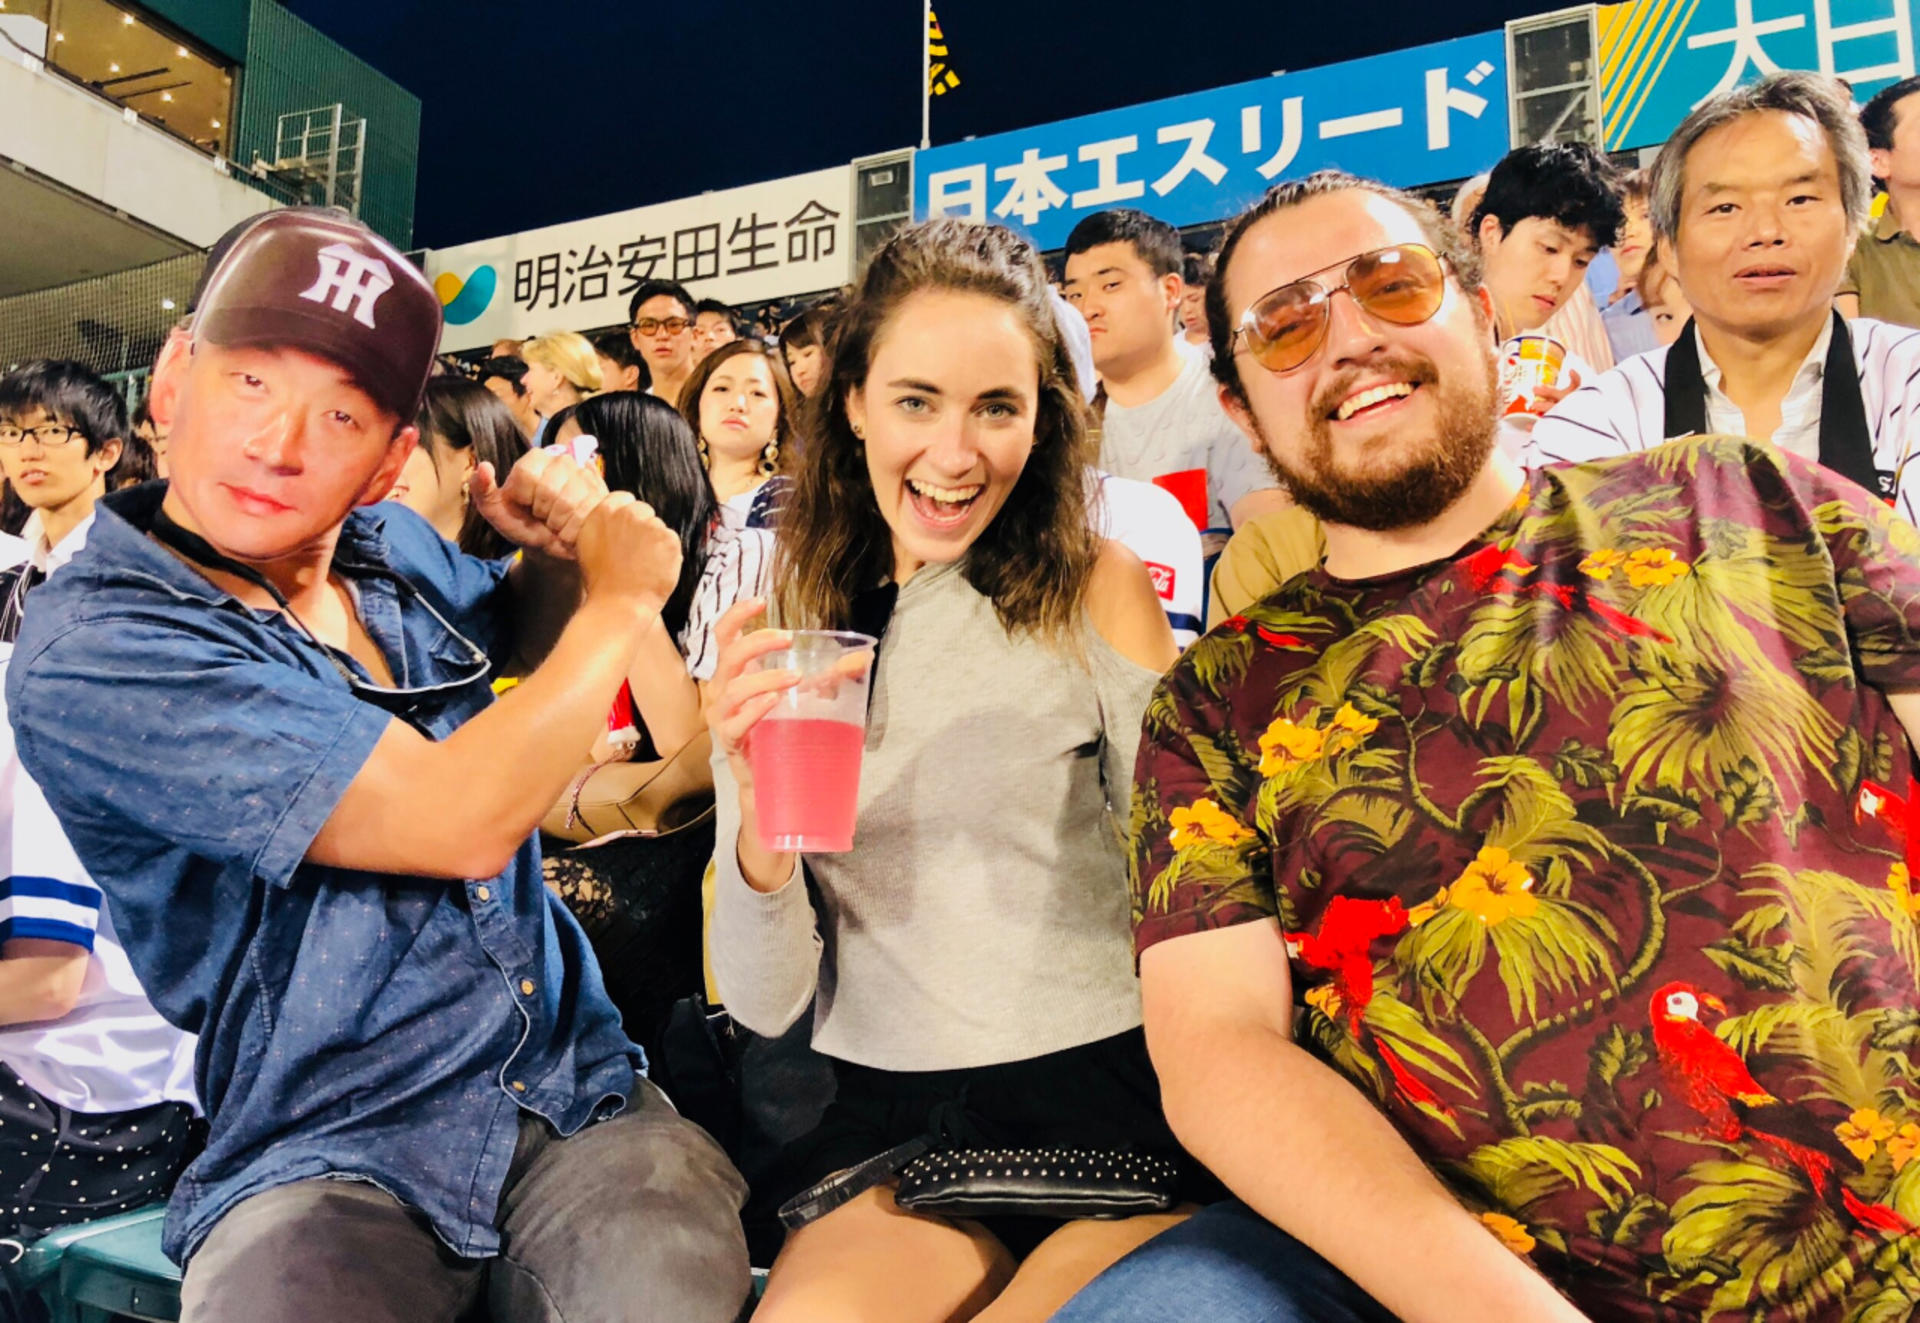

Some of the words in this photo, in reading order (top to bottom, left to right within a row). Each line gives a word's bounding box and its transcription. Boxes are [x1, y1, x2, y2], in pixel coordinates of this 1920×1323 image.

[929, 60, 1495, 226] 日本エスリード
[514, 200, 840, 312] 明治安田生命
